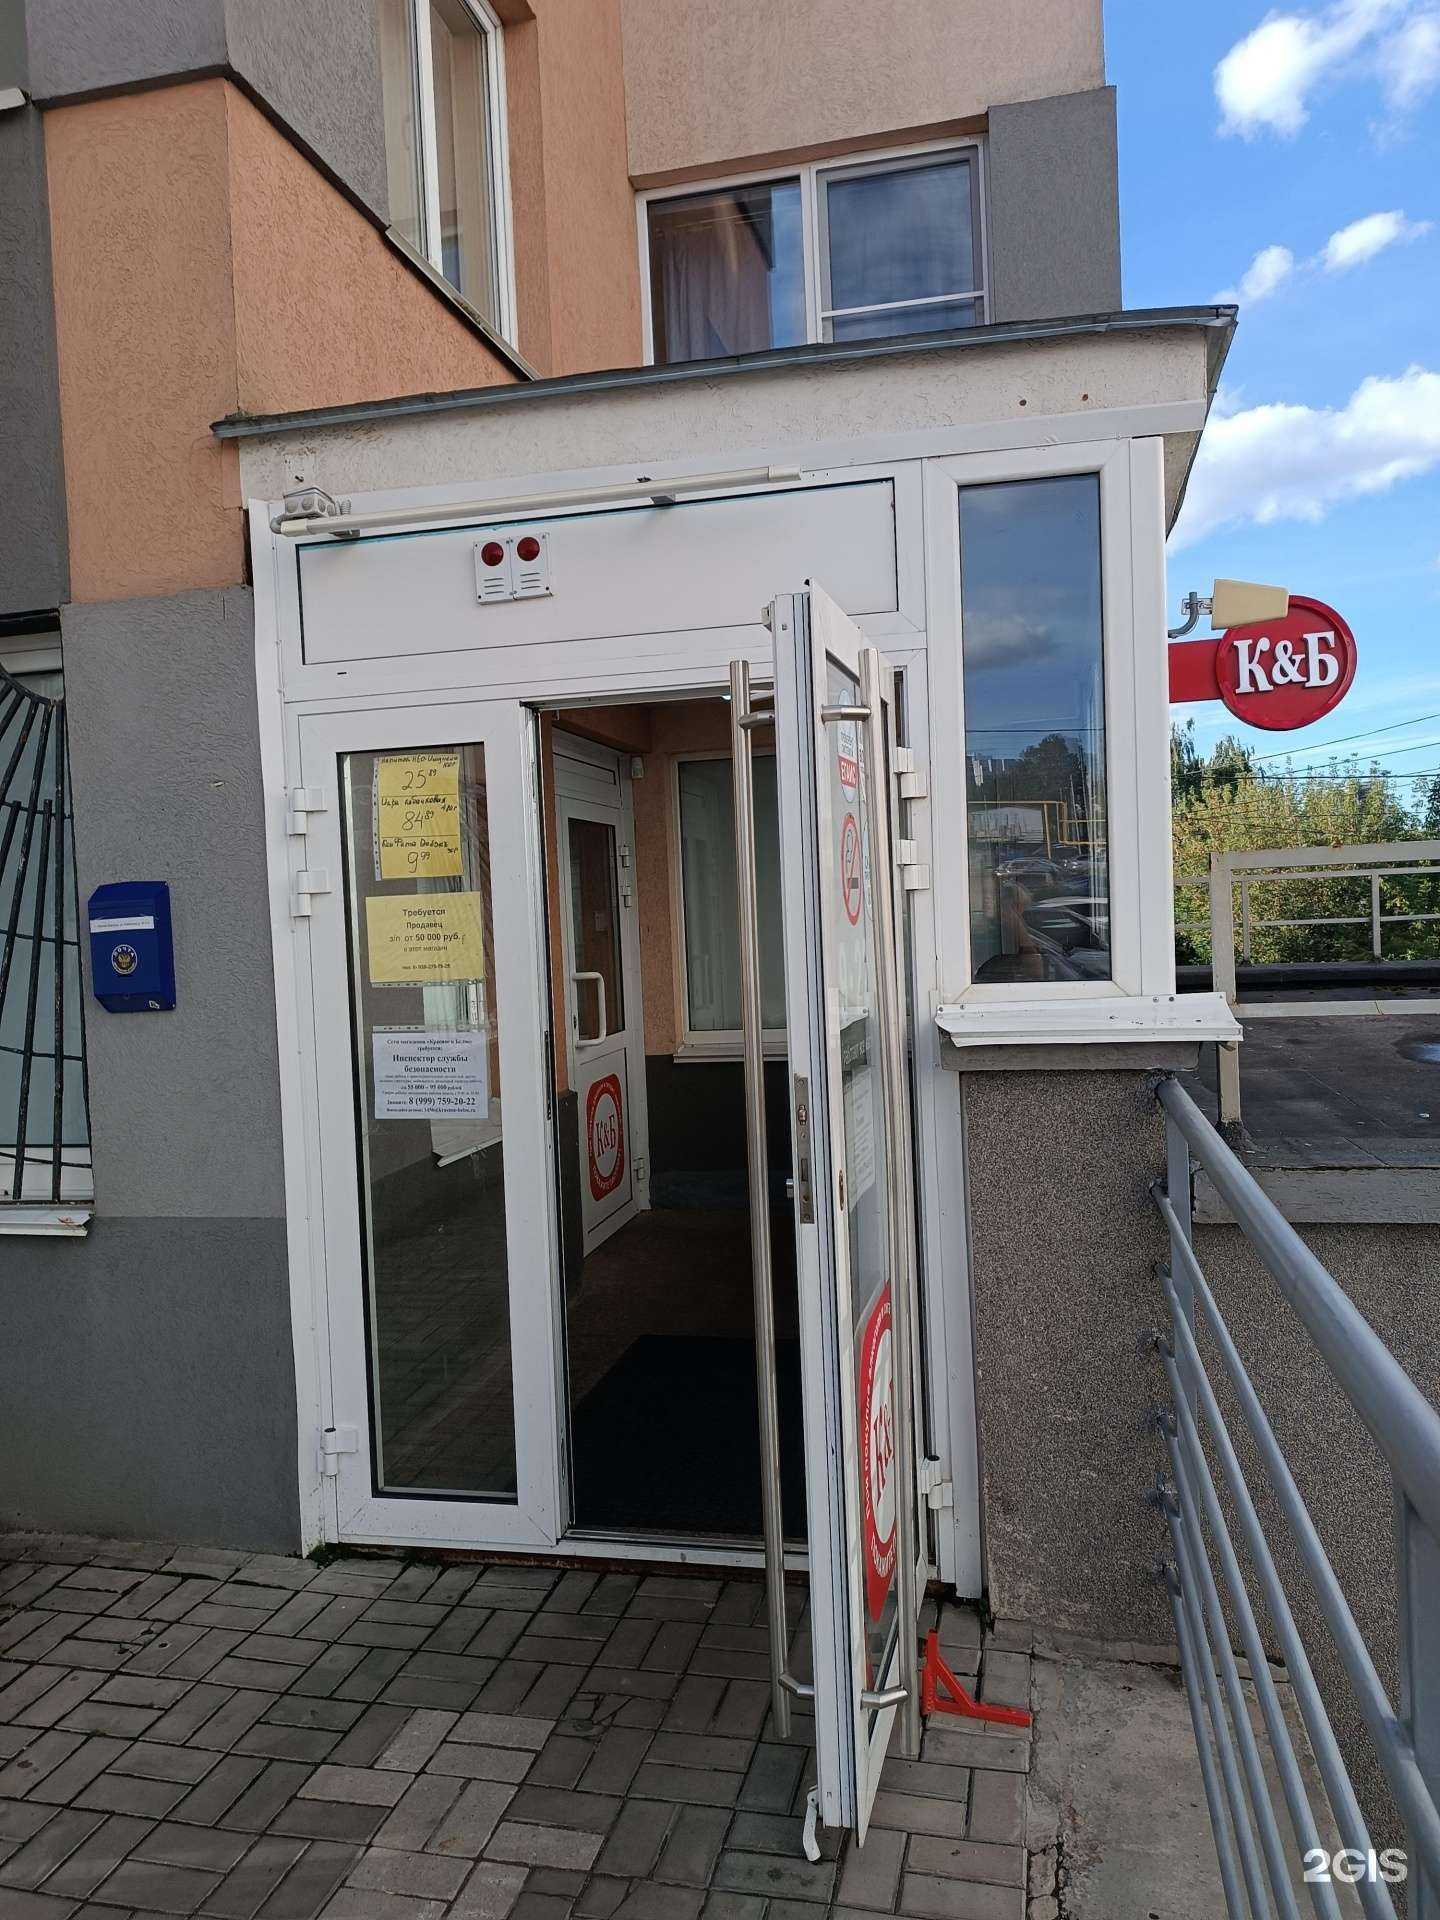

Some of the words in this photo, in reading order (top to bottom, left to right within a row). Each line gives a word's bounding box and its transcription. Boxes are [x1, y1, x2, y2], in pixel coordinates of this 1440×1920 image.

[1233, 631, 1339, 694] К&Б
[401, 769, 427, 790] 25
[402, 907, 446, 918] Требуется
[406, 921, 443, 930] Продавец
[426, 933, 441, 942] 000
[392, 1054, 436, 1064] Инспектор
[437, 1054, 468, 1064] службы
[404, 1065, 456, 1073] безопасности
[408, 1096, 414, 1105] 8
[437, 1096, 476, 1106] 759-20-22
[596, 1114, 616, 1158] К&Б
